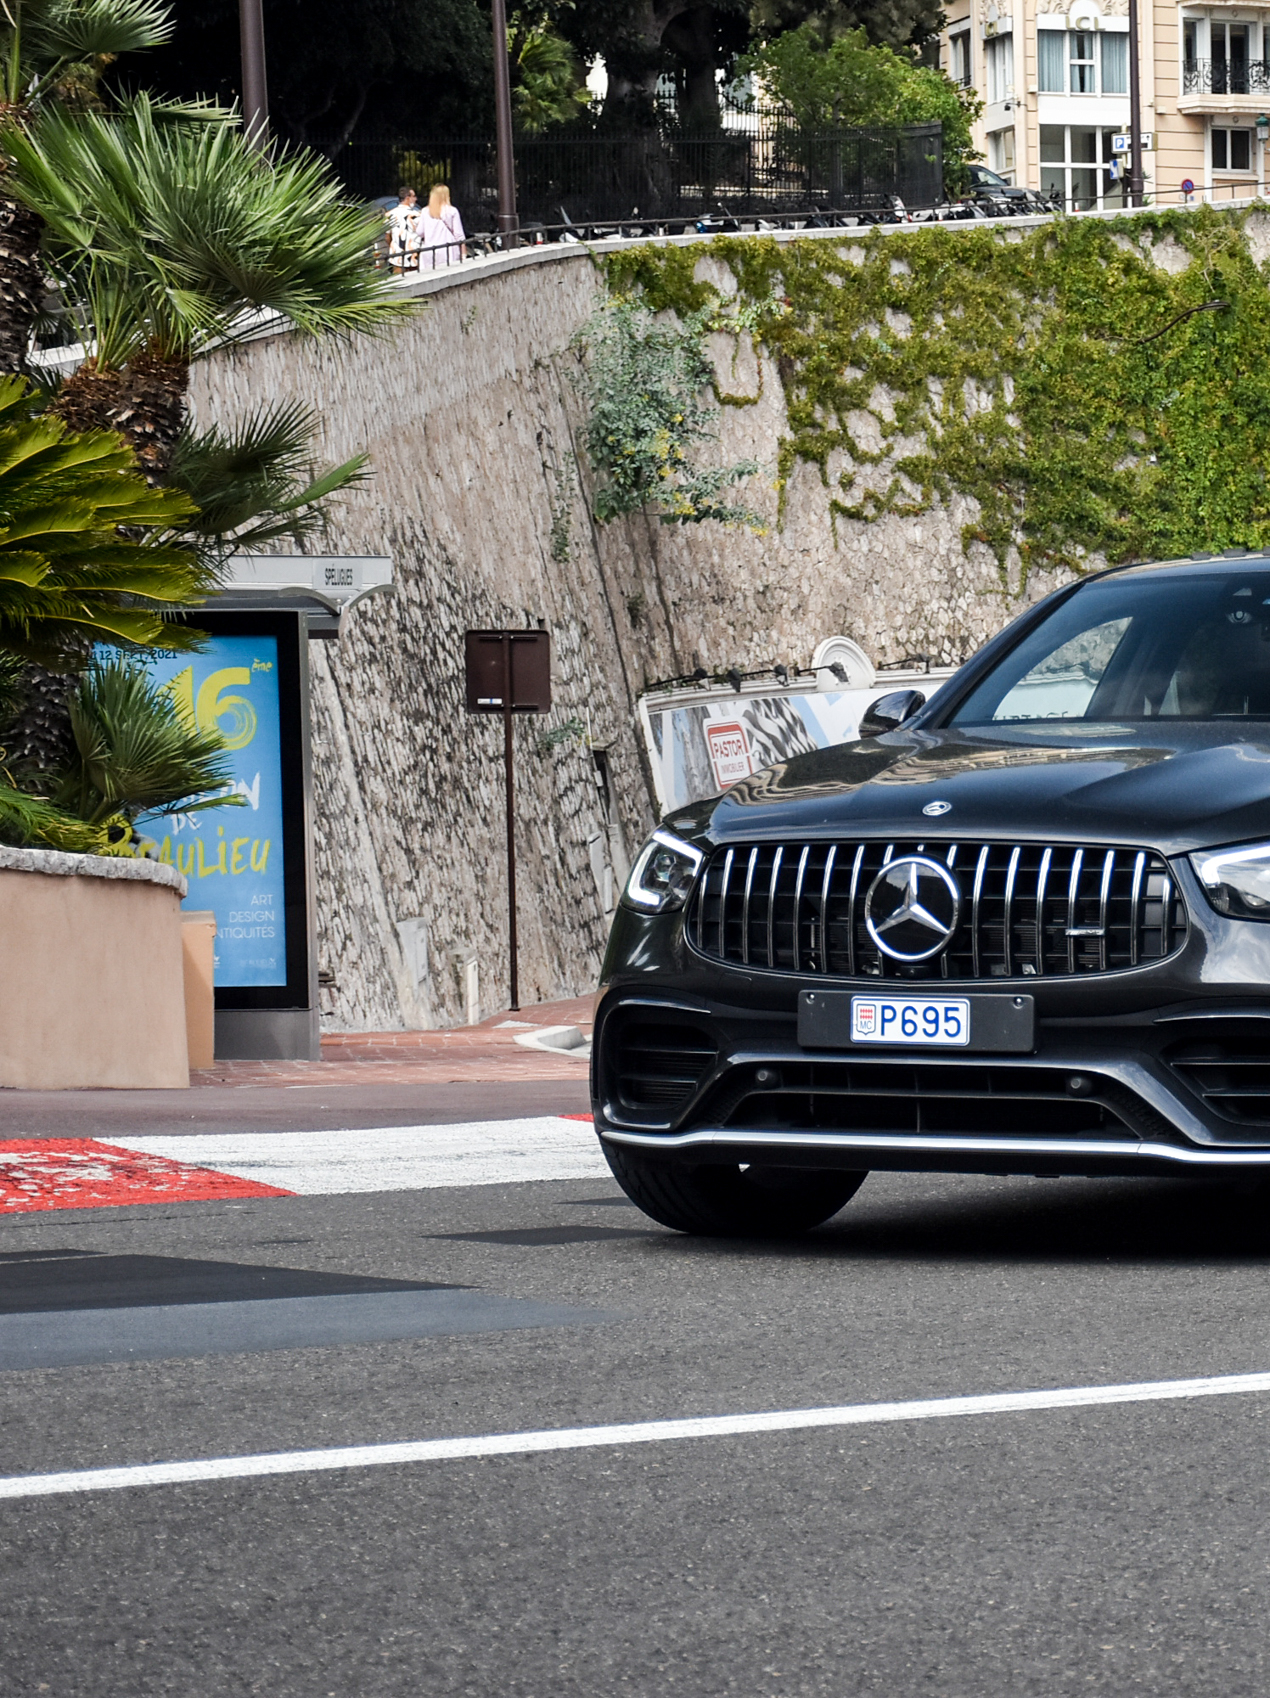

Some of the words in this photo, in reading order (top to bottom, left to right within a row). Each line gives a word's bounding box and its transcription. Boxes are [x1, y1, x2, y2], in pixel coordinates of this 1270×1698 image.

[1065, 16, 1106, 31] LCL
[325, 563, 353, 586] SPÉLUGUES
[151, 650, 178, 660] 2021
[155, 665, 257, 751] 16
[251, 657, 273, 673] ème
[714, 739, 744, 759] PASTOR
[170, 811, 203, 836] DE
[250, 894, 274, 906] ART
[229, 910, 275, 923] DESIGN
[216, 924, 275, 939] NTIQUITÉS
[860, 1020, 873, 1030] MC
[880, 1005, 962, 1038] P695
